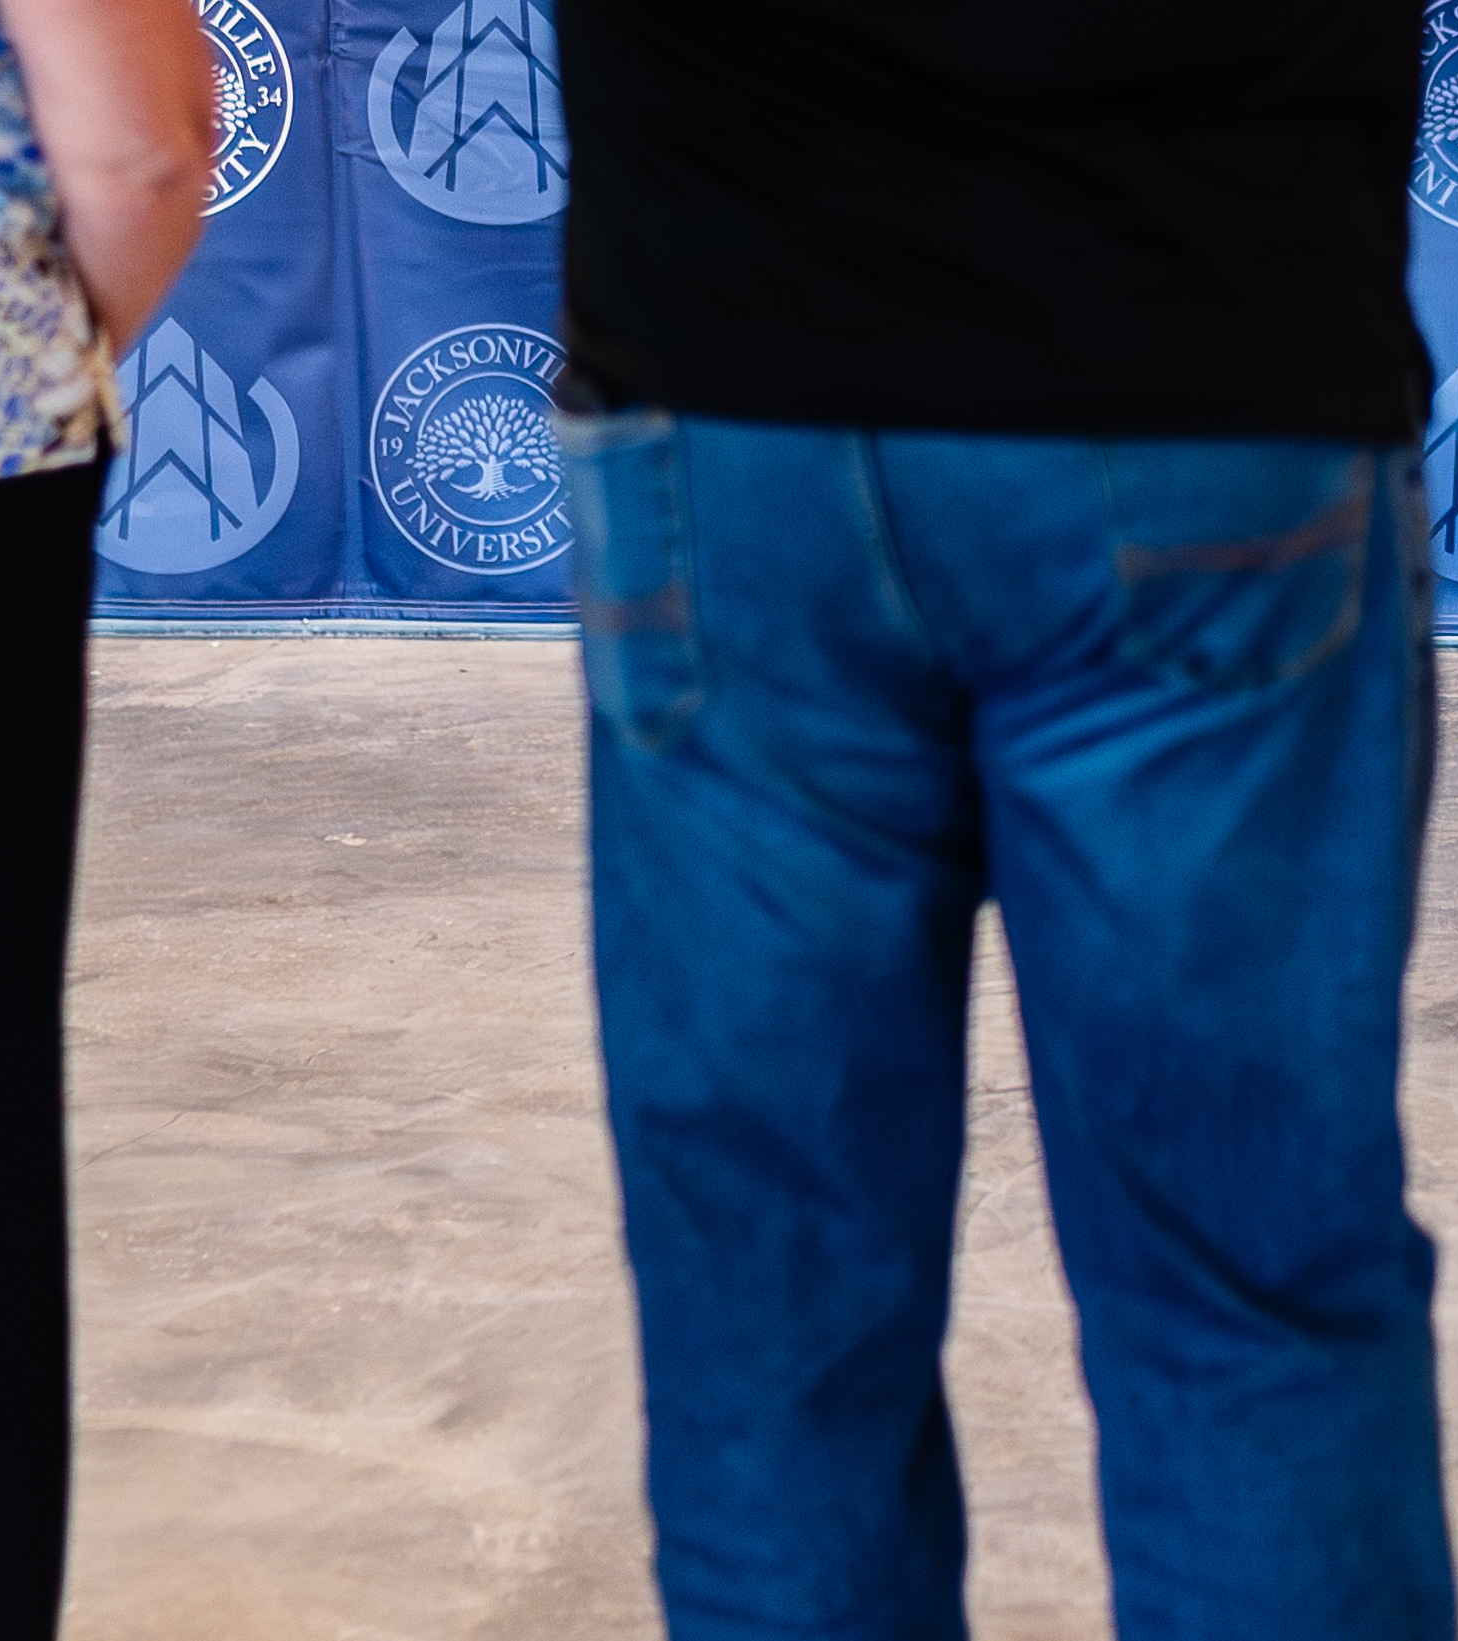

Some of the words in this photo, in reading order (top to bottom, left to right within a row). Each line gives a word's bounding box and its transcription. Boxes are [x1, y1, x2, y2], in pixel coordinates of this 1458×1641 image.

[257, 86, 282, 107] 34
[384, 335, 567, 433] JACKSONVIL
[380, 438, 403, 457] 19
[391, 475, 573, 563] UNIVERSIT
